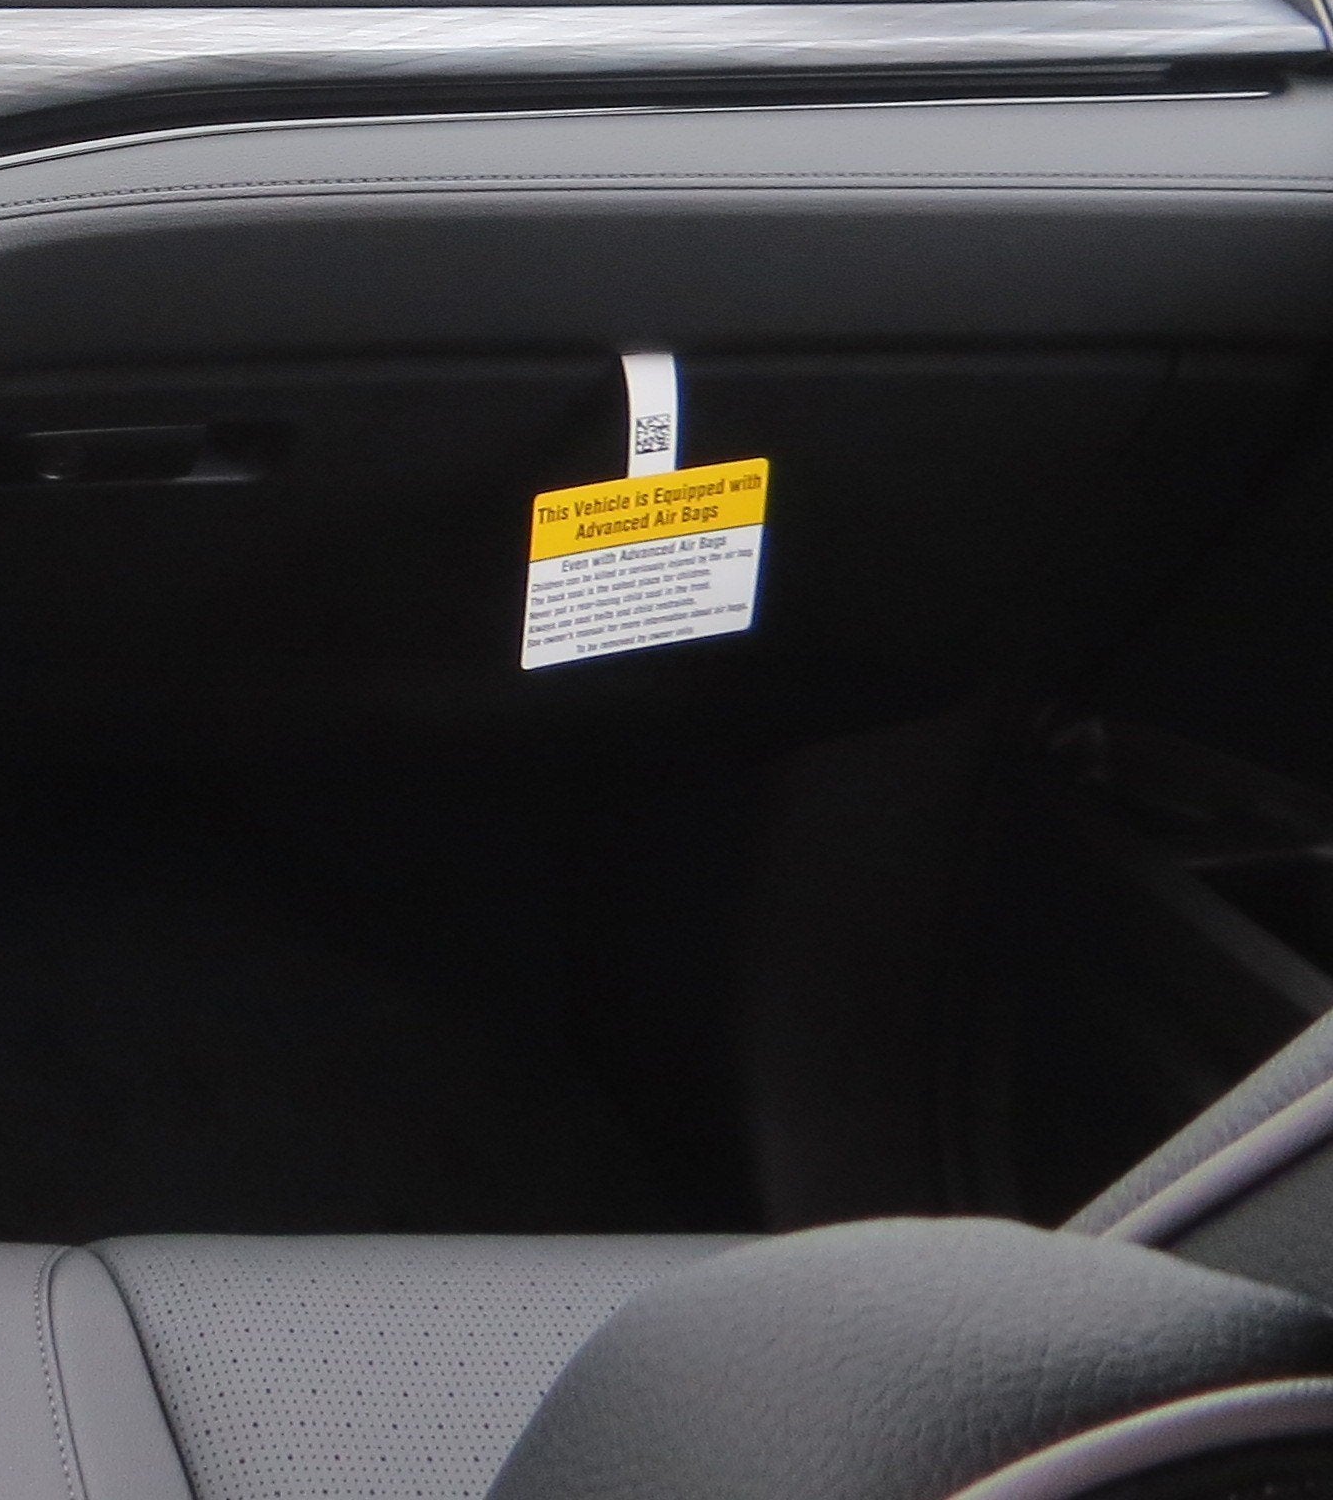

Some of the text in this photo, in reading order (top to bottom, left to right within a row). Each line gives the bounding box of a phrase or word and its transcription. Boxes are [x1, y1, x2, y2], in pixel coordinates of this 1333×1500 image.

[537, 473, 763, 525] This Vehicle is Equipped with
[575, 503, 719, 541] Advanced Air Bags
[561, 557, 589, 574] Even
[592, 551, 616, 568] with
[619, 542, 676, 563] Advanced
[679, 538, 696, 553] Air
[699, 534, 727, 552] Bags
